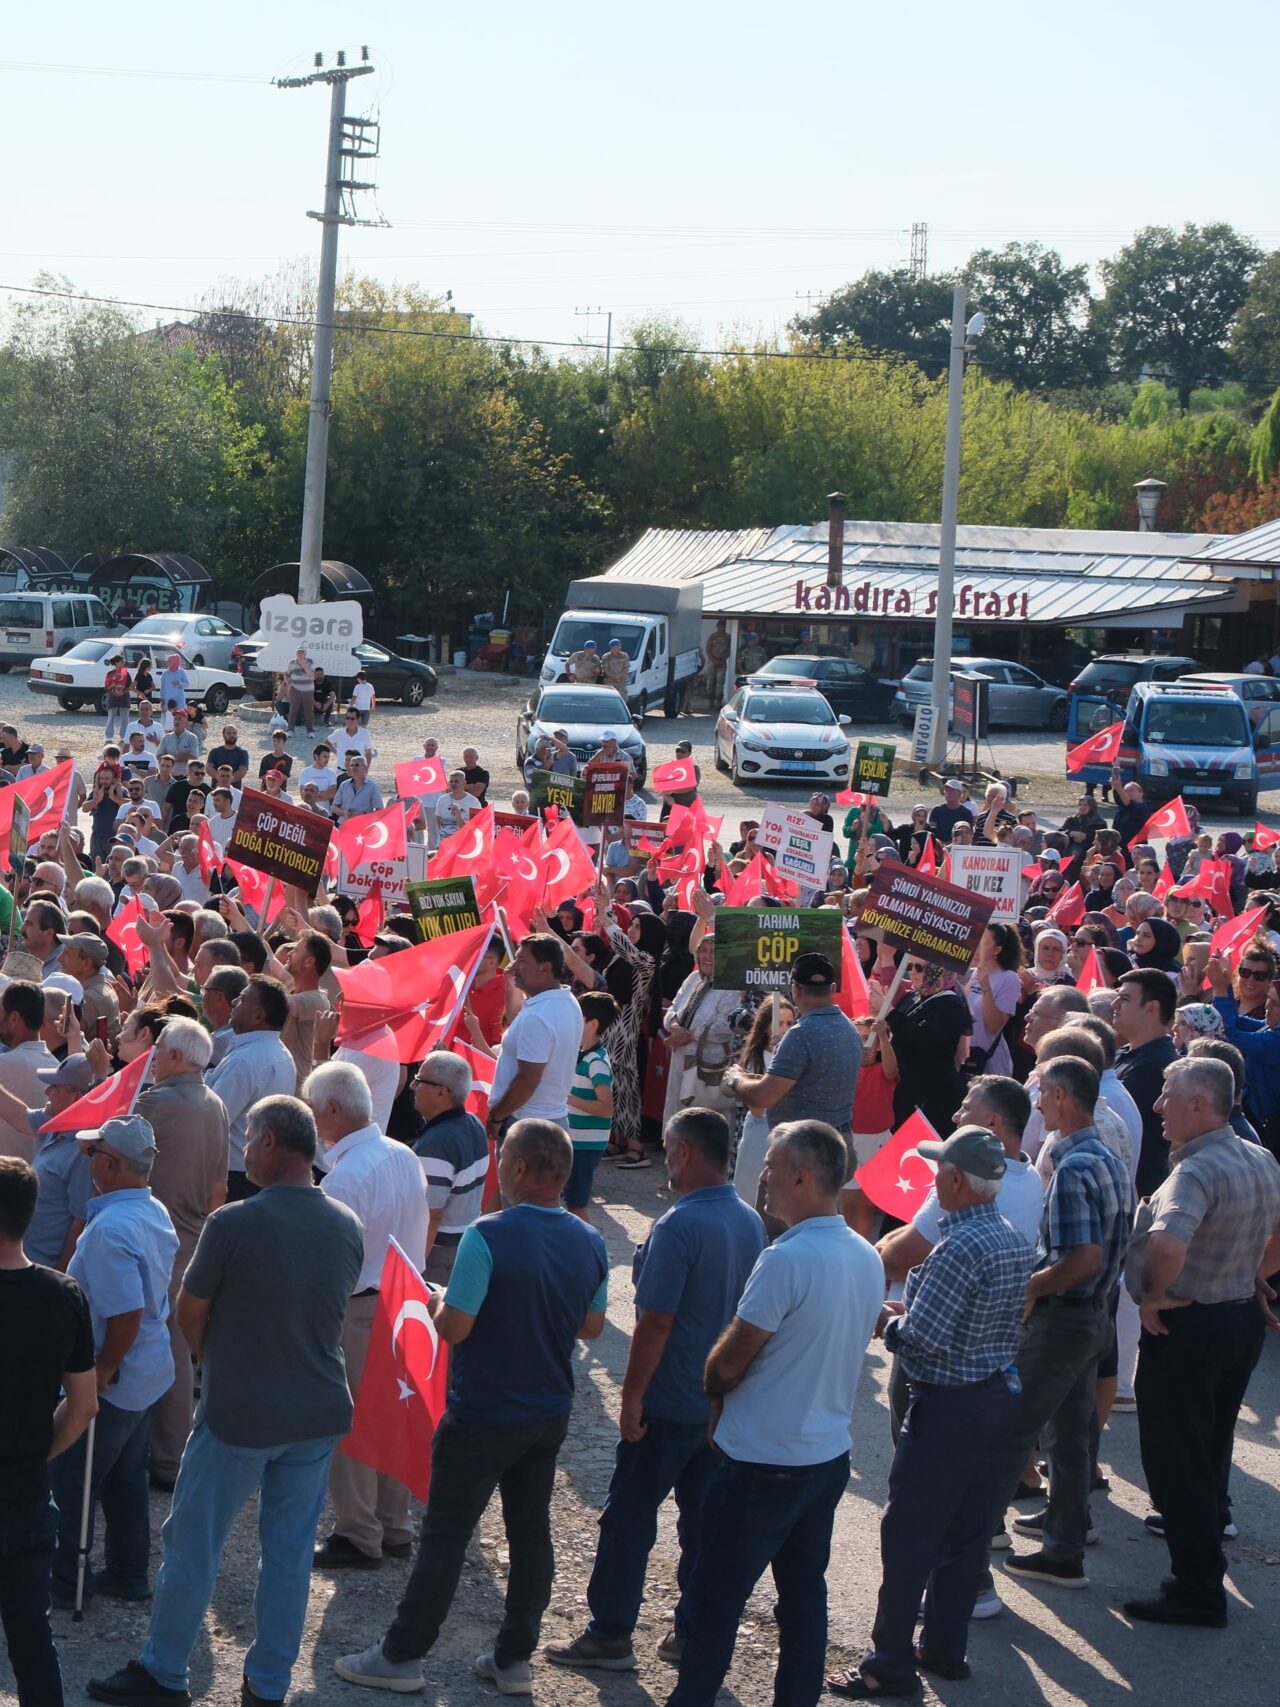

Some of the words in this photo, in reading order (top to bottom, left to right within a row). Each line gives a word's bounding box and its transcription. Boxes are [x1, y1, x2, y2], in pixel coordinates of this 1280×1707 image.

[795, 579, 911, 614] kandıra
[925, 584, 1028, 618] sfrası
[265, 610, 353, 639] Izgara
[591, 793, 617, 815] HAYIR!
[256, 811, 279, 833] ÇÖP
[278, 821, 307, 847] DEĞİL
[235, 829, 262, 854] DOĞA
[263, 837, 320, 877] İSTİYORUZ!
[961, 855, 1010, 873] KANDIRALI
[370, 861, 394, 878] Çöp
[966, 874, 981, 891] BU
[983, 875, 1005, 893] KEZ
[418, 892, 433, 910] BİZİ
[431, 894, 447, 908] YOK
[444, 891, 466, 907] SAYAN
[891, 877, 922, 899] ŞİMDİ
[920, 888, 972, 919] YANIMIZDA
[757, 914, 800, 929] TARIMA
[877, 894, 924, 921] OLMAYAN
[921, 910, 972, 941] SİYASETÇİ
[757, 931, 800, 967] ÇÖP
[861, 908, 913, 939] KÖYÜMÜZE
[911, 928, 972, 962] UĞRAMASIN!
[745, 967, 793, 985] DÖKMEY
